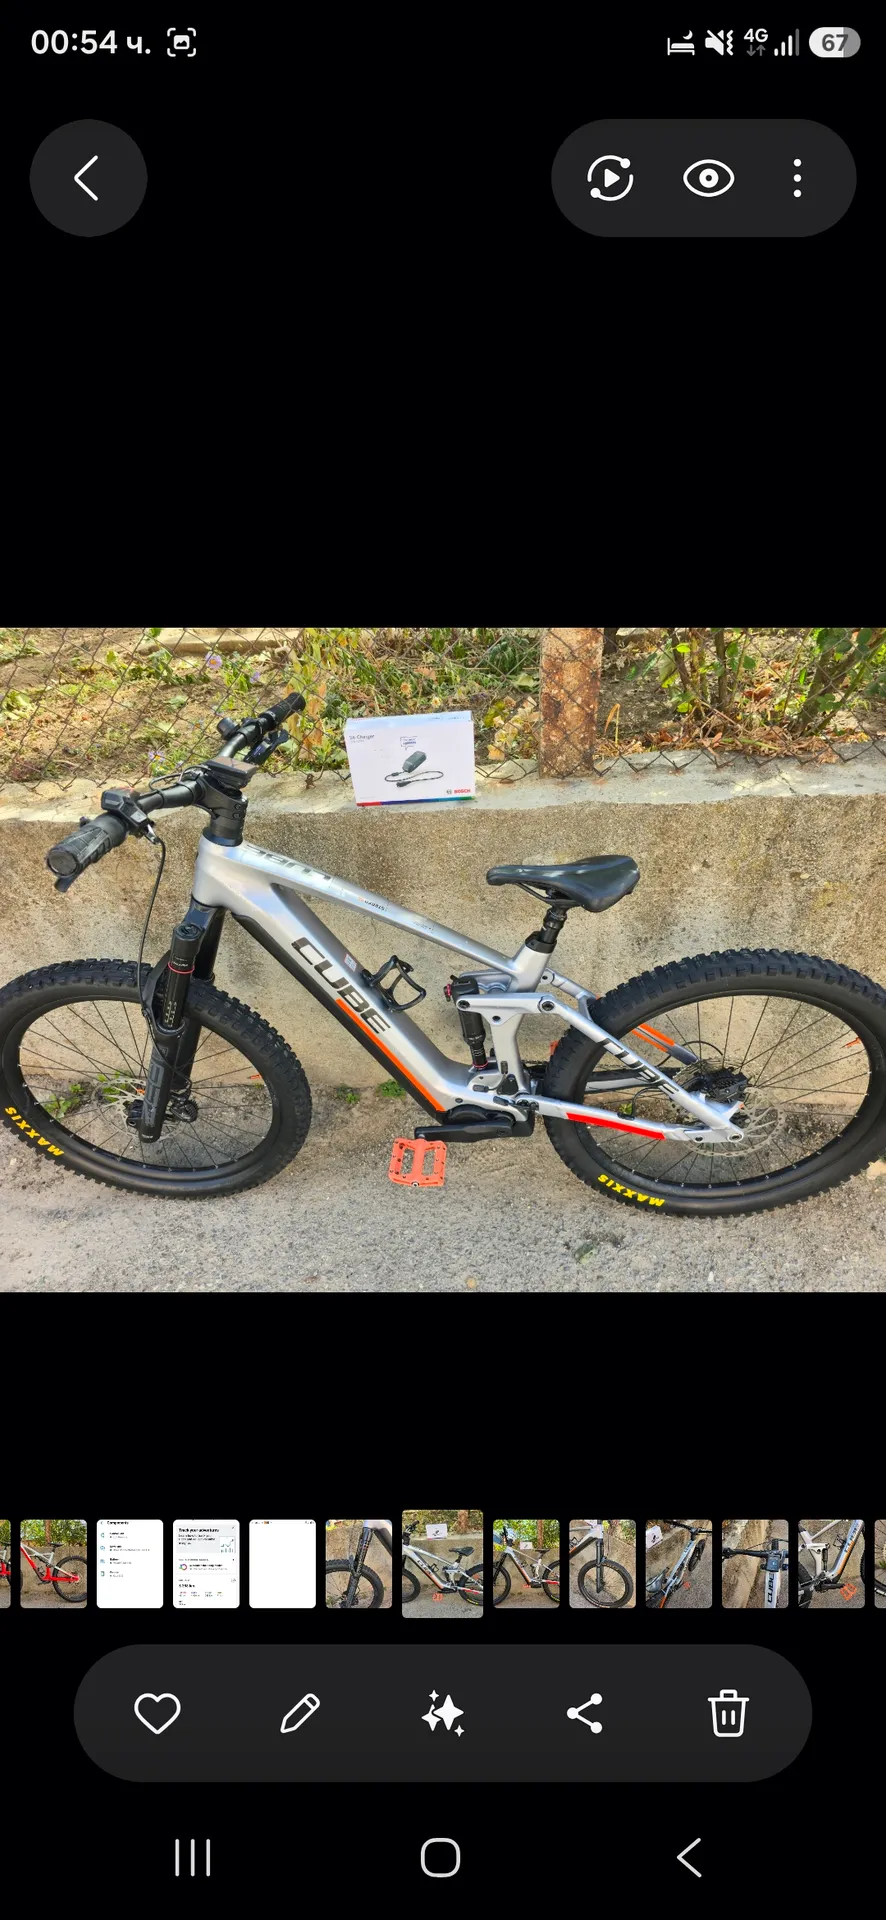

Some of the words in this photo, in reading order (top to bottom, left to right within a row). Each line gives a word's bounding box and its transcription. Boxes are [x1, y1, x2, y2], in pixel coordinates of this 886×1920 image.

[31, 29, 118, 55] 00:54
[126, 36, 151, 55] ч.
[743, 28, 769, 43] 4G
[821, 33, 849, 52] 67
[291, 937, 391, 1034] CUBE
[602, 1038, 680, 1095] CUBE
[4, 1106, 65, 1156] MAXXIS
[597, 1174, 666, 1207] MAXXIS
